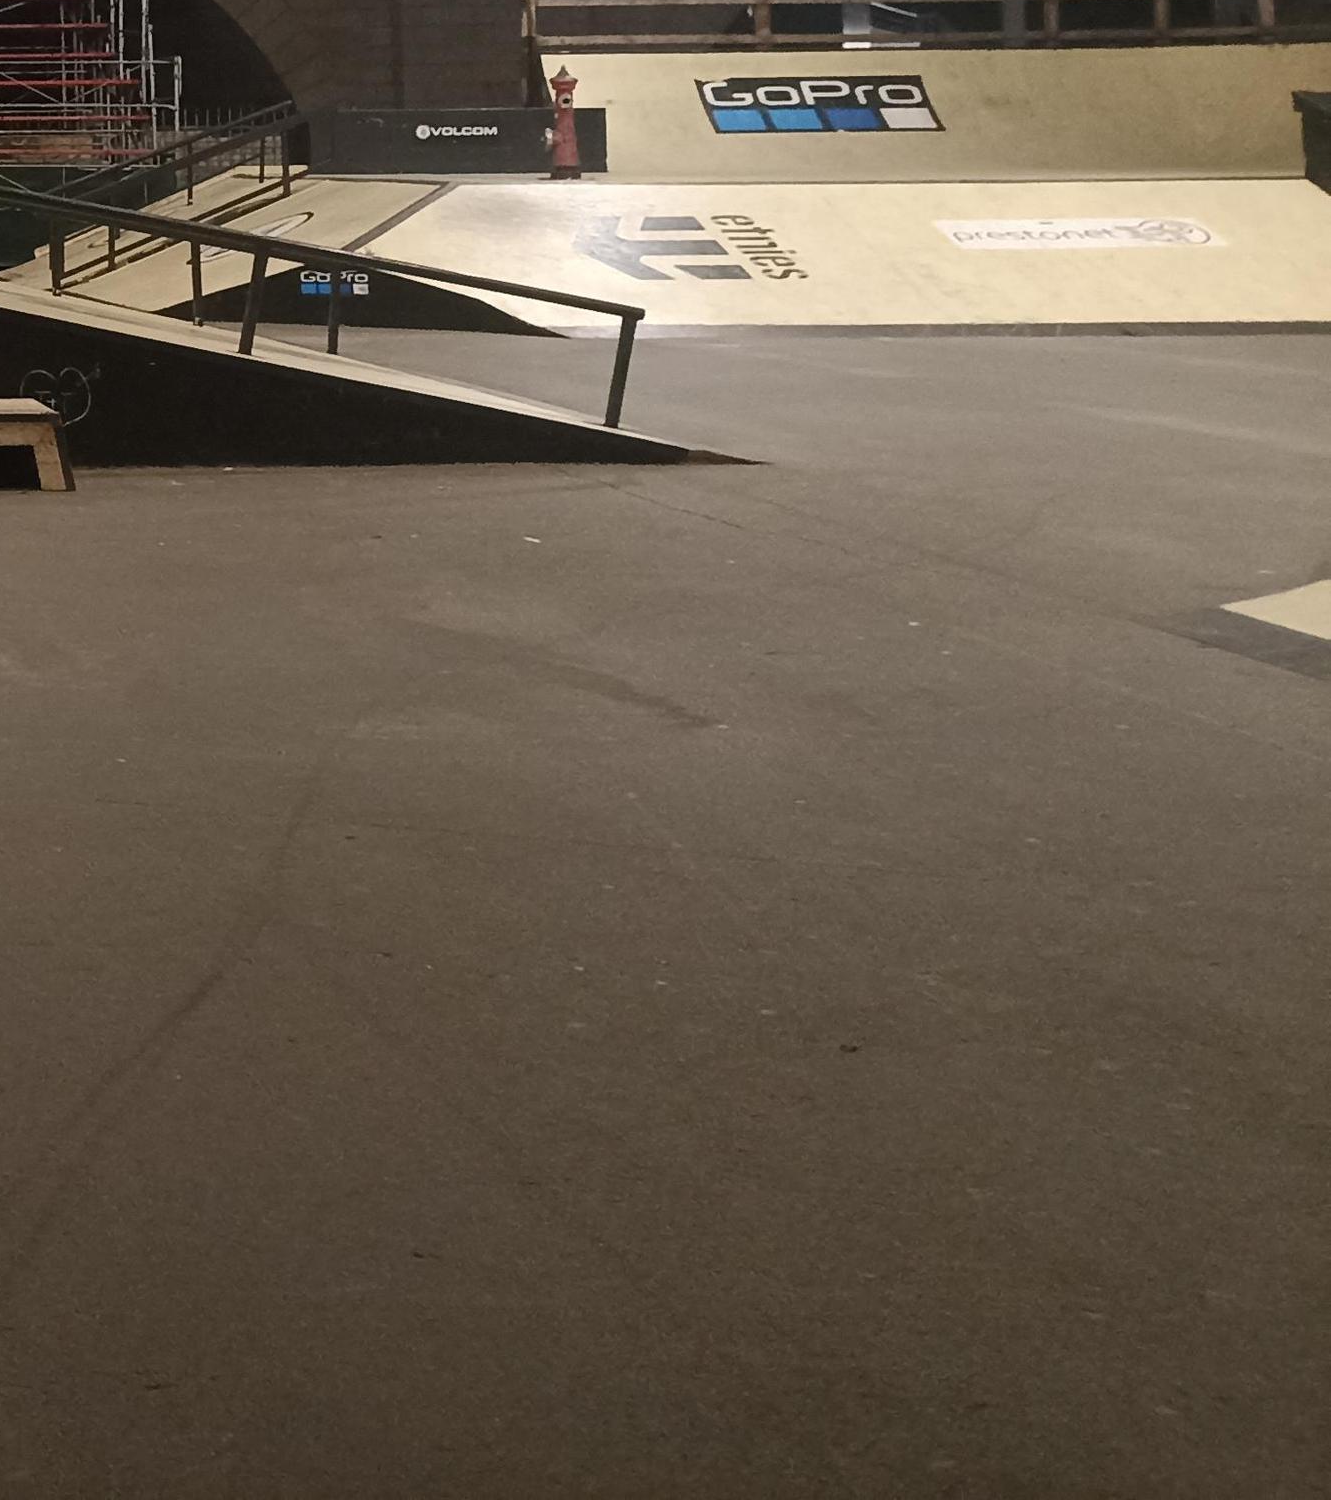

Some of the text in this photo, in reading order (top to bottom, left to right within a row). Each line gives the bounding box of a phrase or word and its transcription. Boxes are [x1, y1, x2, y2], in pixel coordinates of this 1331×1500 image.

[702, 80, 924, 107] GoPro
[430, 126, 498, 137] VOLCOM
[710, 214, 809, 280] etnies
